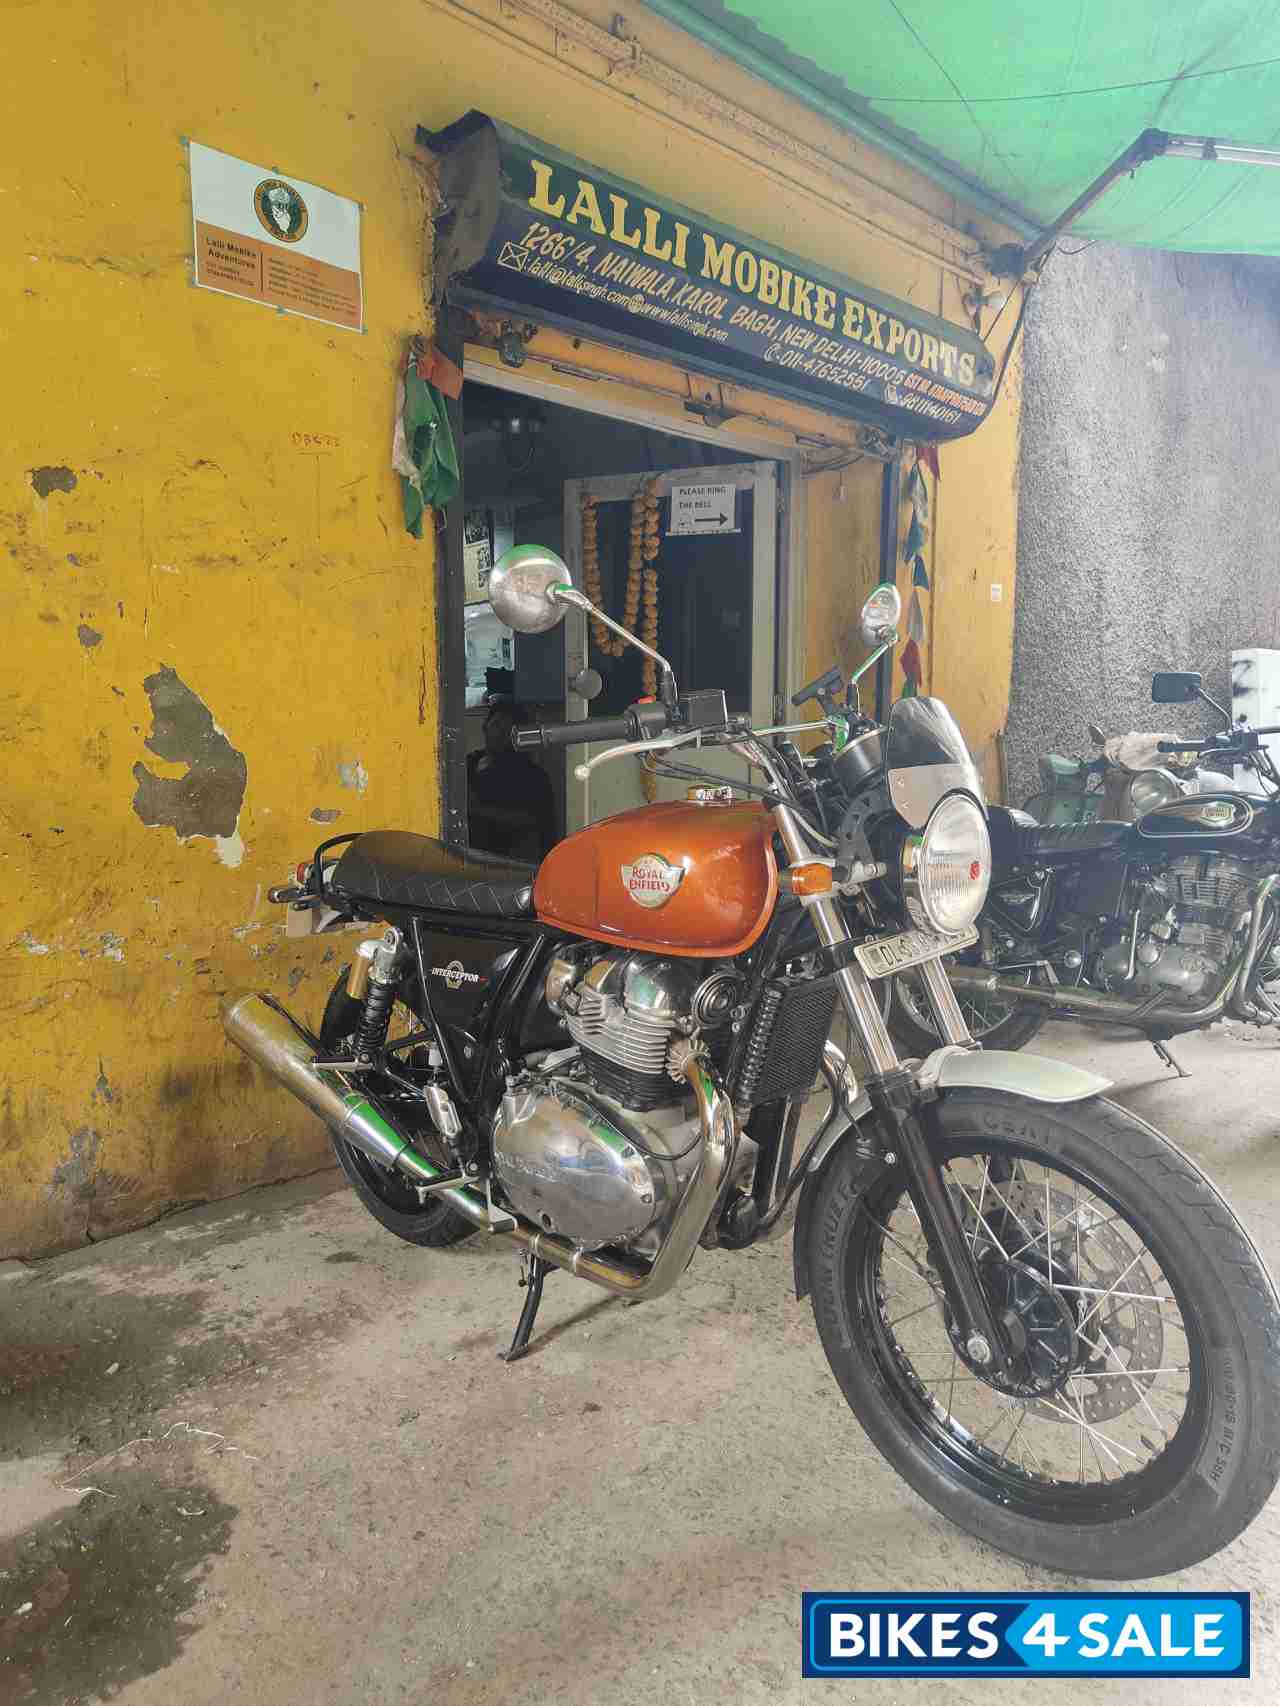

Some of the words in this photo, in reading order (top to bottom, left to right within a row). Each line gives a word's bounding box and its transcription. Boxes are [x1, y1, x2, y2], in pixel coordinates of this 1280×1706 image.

[528, 159, 690, 268] LALLI
[701, 232, 837, 330] MOBIKE
[842, 298, 976, 386] EXPORTS
[781, 323, 817, 350] NEW
[632, 866, 664, 880] ROYAL
[629, 879, 671, 892] ENFIELD
[431, 967, 480, 983] INTERCEPTOR
